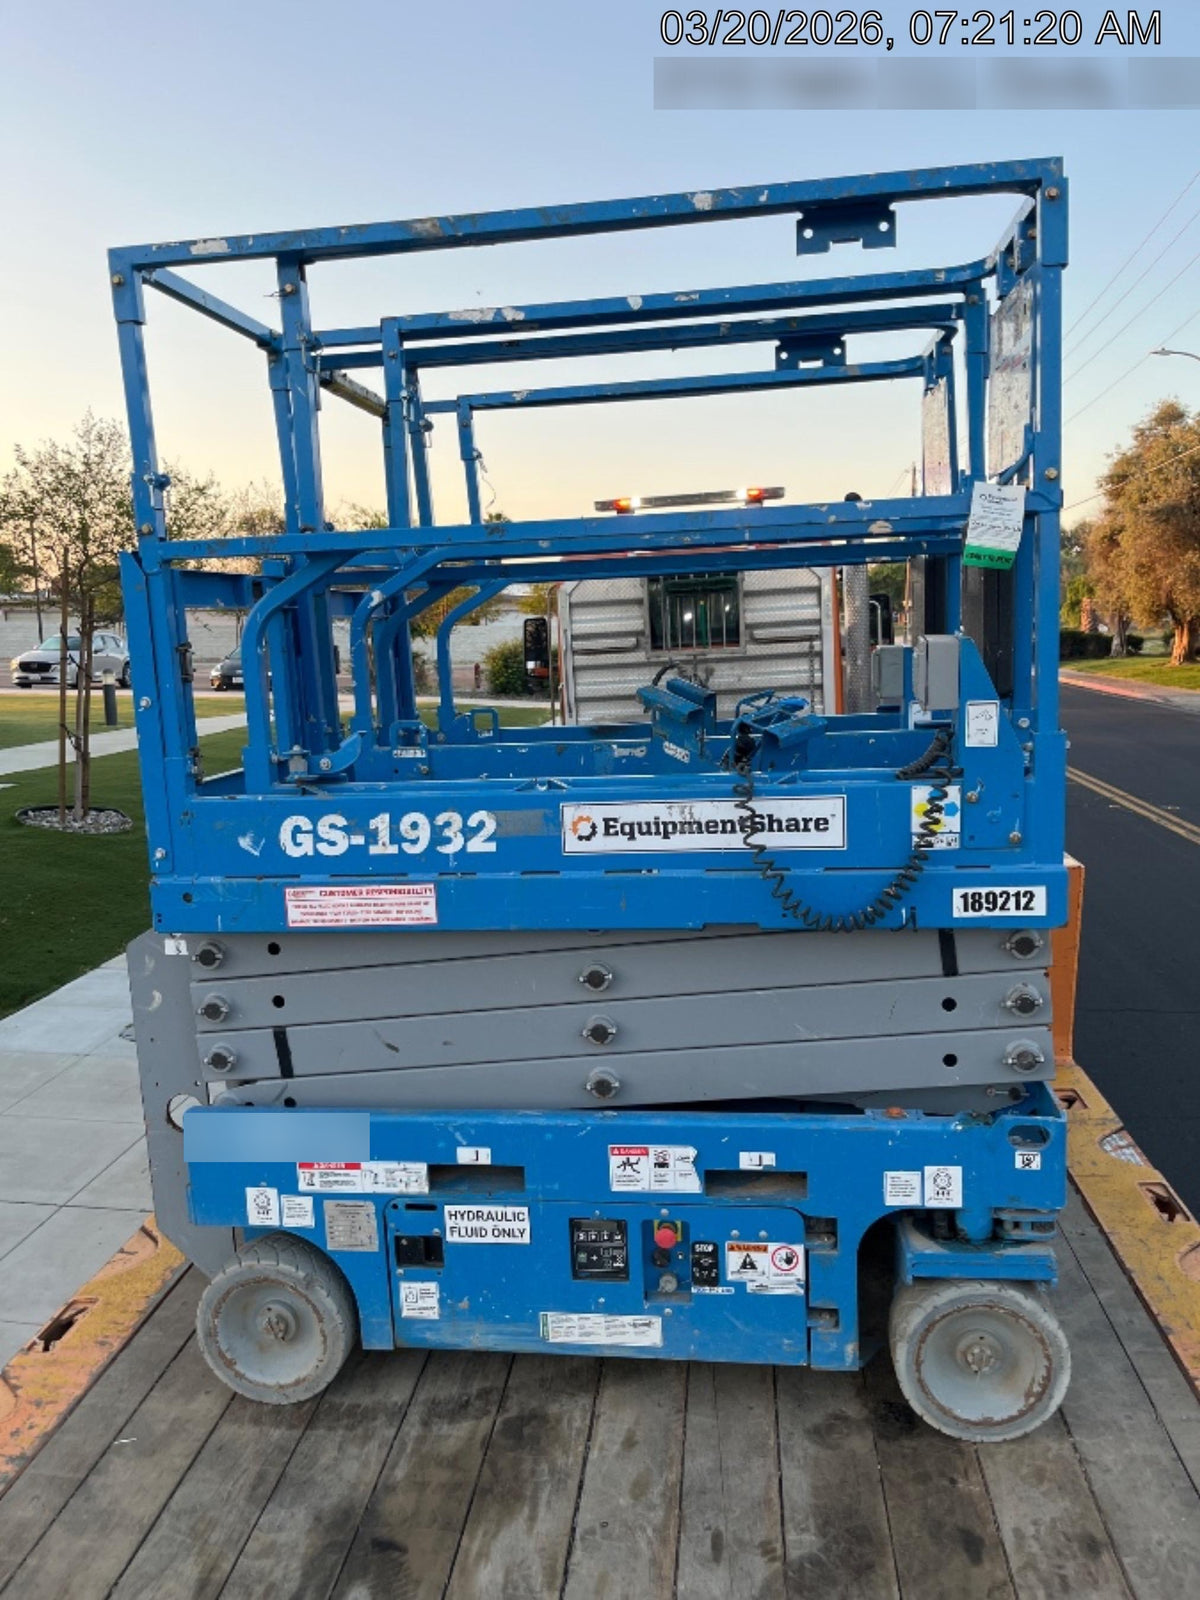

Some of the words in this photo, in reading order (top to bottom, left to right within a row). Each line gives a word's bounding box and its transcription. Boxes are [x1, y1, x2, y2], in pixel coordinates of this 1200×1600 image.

[280, 810, 497, 857] GS-1932
[960, 889, 1036, 912] 189212
[447, 1209, 526, 1223] HYDRAULIC
[449, 1226, 488, 1239] FLUID
[491, 1227, 527, 1239] ONLY
